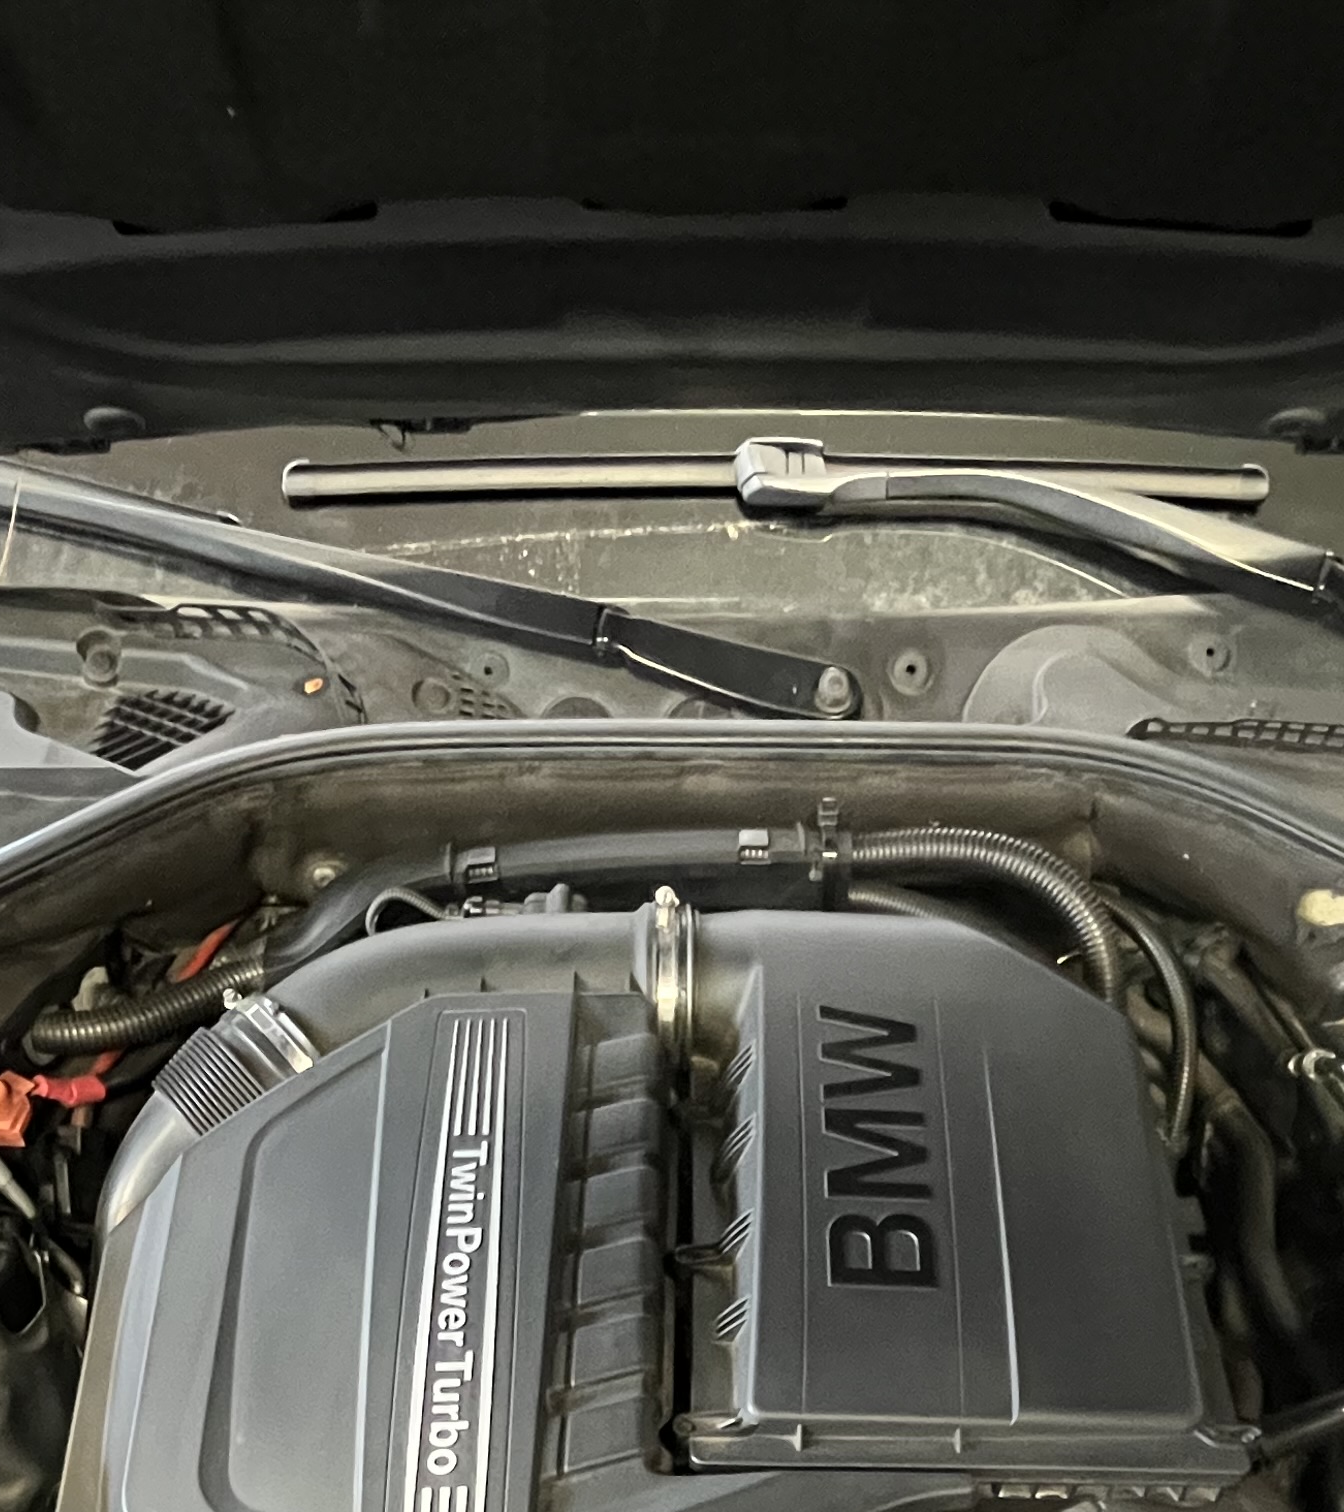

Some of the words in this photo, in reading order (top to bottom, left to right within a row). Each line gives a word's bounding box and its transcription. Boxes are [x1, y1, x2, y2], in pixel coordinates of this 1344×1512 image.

[437, 1140, 488, 1348] TwinPower
[819, 1005, 938, 1290] BMW
[426, 1350, 474, 1476] Turbo
